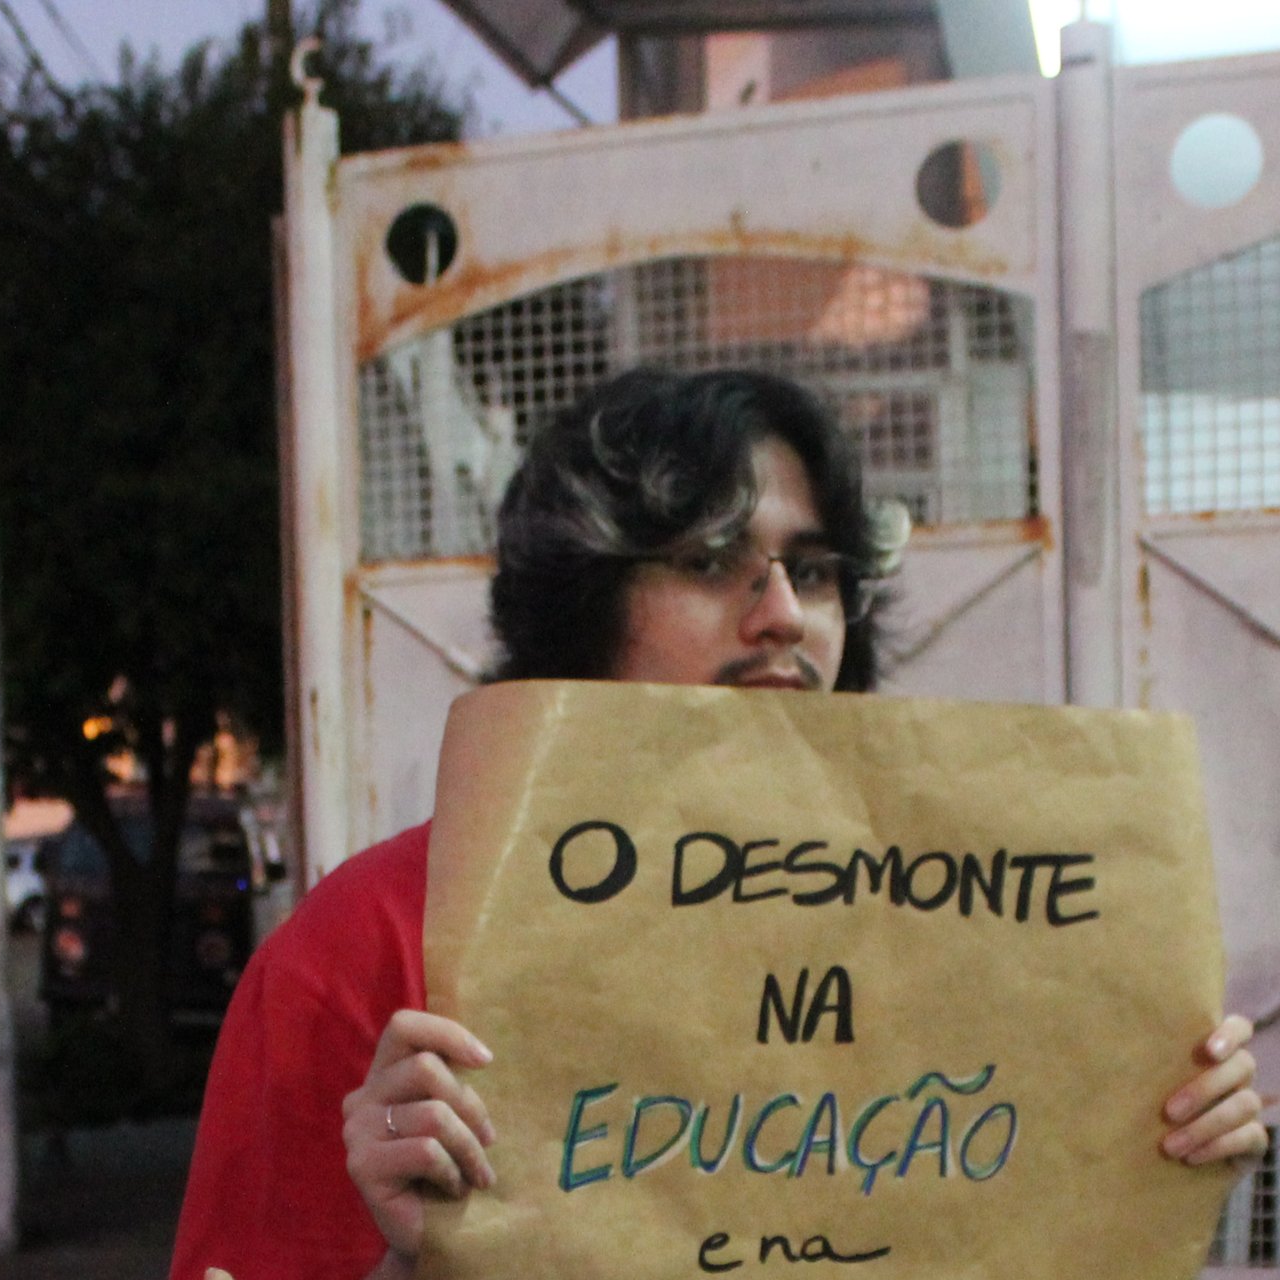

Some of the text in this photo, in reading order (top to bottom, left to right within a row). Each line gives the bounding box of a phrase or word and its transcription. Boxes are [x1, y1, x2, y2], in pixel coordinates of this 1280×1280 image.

[549, 820, 1099, 927] O DESMONTE
[756, 965, 856, 1045] NA
[558, 1063, 1018, 1196] EDUCAÇÃO
[696, 1231, 744, 1273] e
